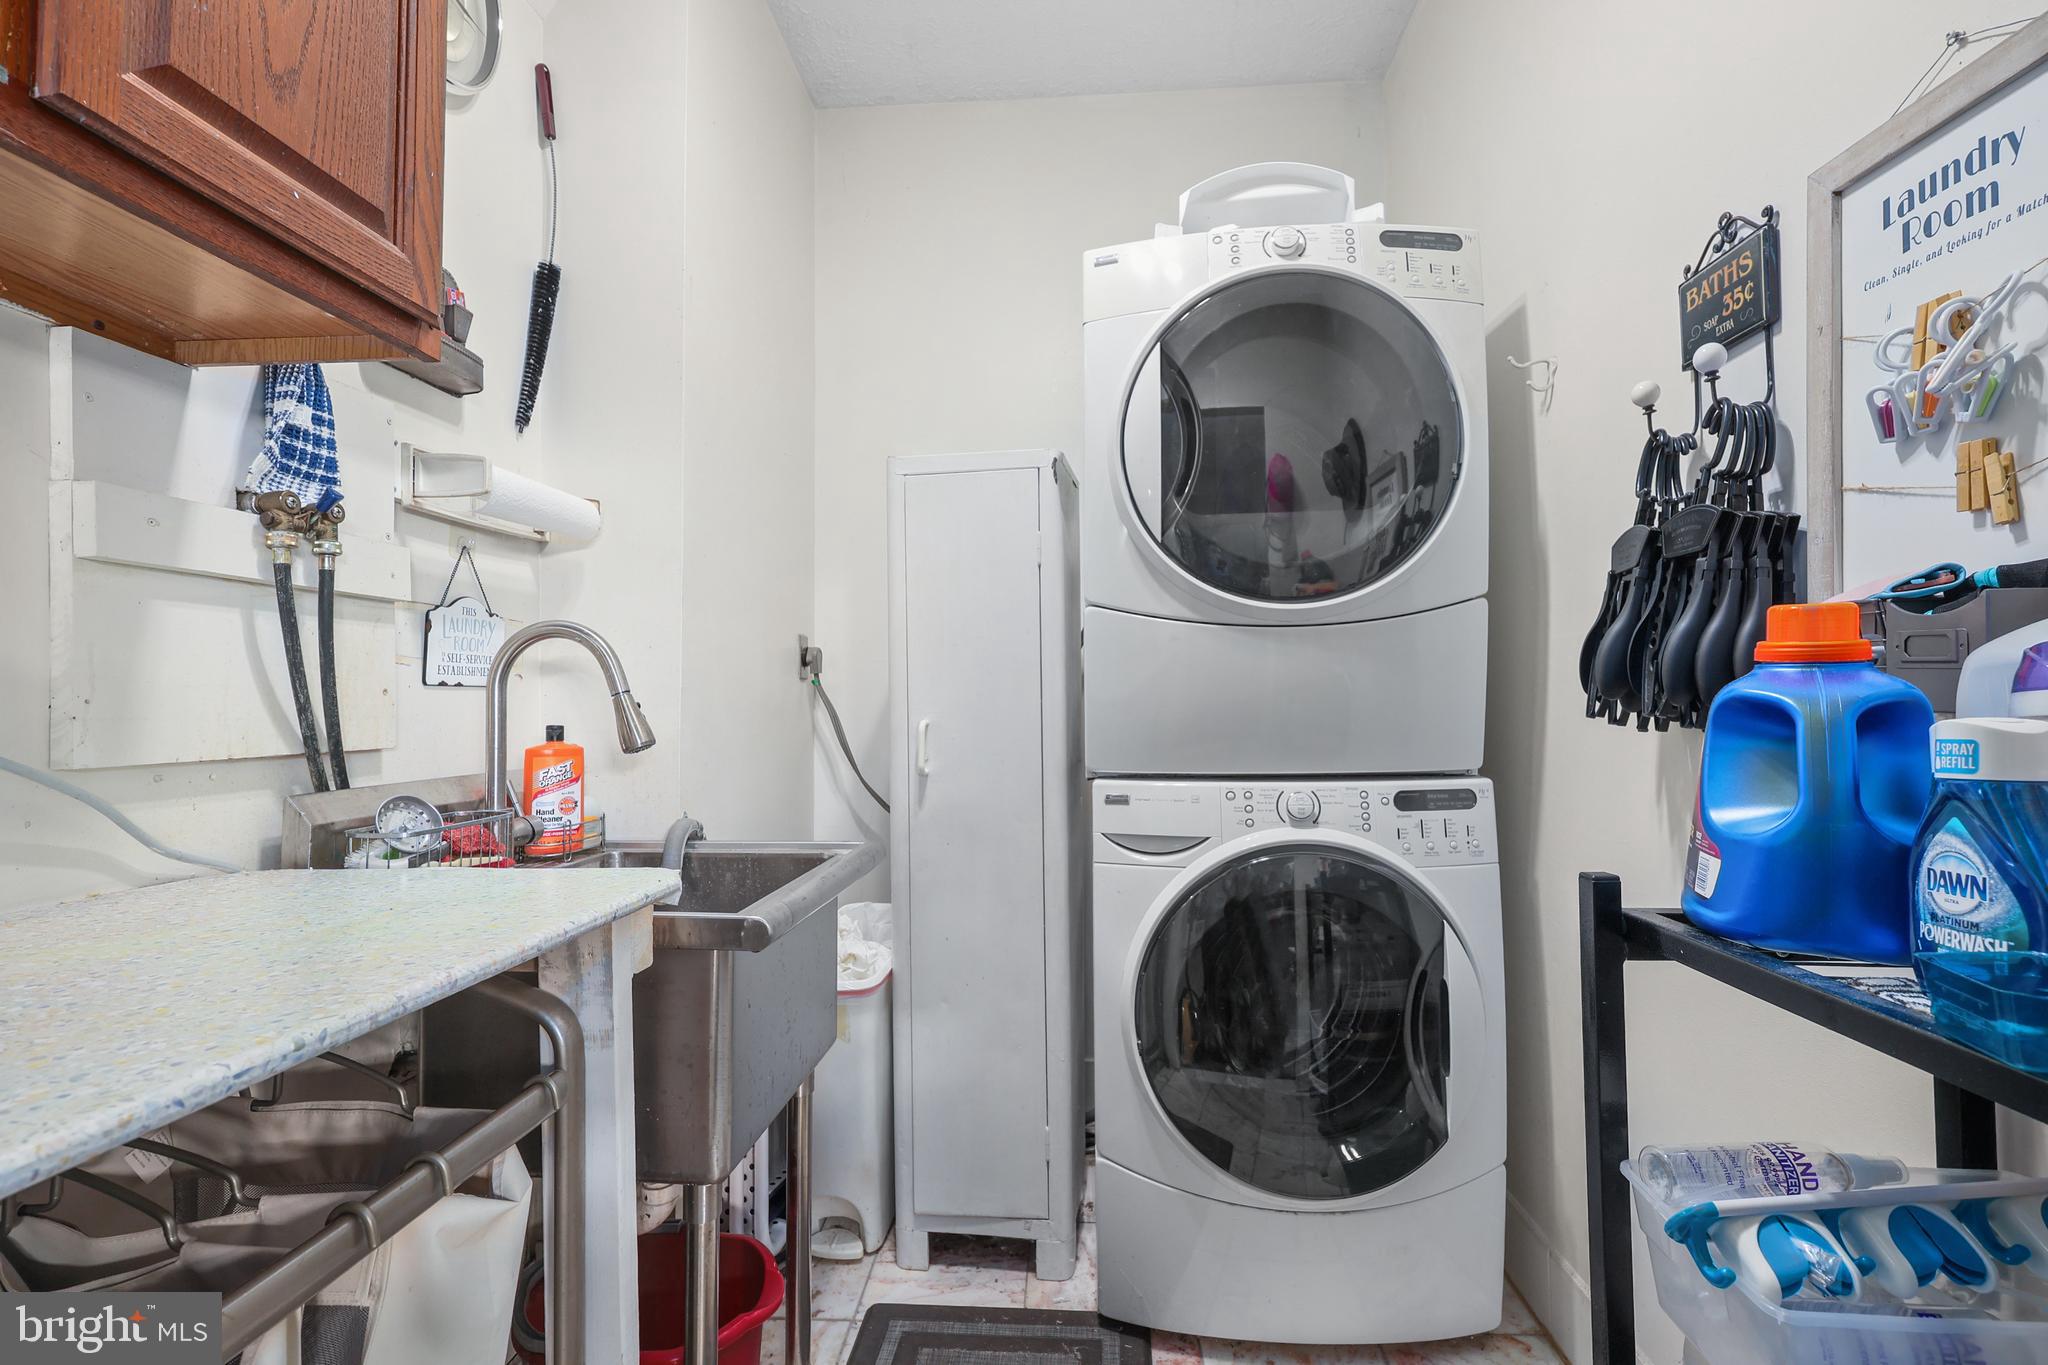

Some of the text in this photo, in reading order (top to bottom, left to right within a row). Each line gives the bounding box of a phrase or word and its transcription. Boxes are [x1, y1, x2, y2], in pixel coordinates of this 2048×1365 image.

[1882, 125, 2026, 231] Laundry
[1863, 275, 1889, 292] Clean,
[1892, 258, 1923, 279] Single,
[1925, 245, 1943, 262] and
[1946, 228, 1983, 254] Looking
[1985, 217, 2002, 236] for
[2005, 213, 2012, 223] a
[1686, 249, 1754, 313] BATHS
[1721, 280, 1754, 317] 35¢
[1703, 315, 1719, 332] SOAP
[1715, 318, 1735, 337] EXTRA
[461, 606, 477, 617] THIS
[442, 614, 496, 646] LAUNDRY
[454, 636, 485, 652] ROOM
[446, 653, 492, 665] SELF-SERVICE
[437, 665, 489, 677] ESTABLISHME
[1940, 742, 1975, 756] SPRAY
[539, 760, 574, 781] FAST
[1940, 756, 1976, 769] REFILL
[539, 771, 574, 788] ORANGE
[538, 815, 563, 823] leaner
[1926, 866, 1989, 902] DAWN
[1930, 911, 1980, 932] PLATINUM
[1919, 920, 2009, 953] POWERWASH
[1719, 1145, 1740, 1169] cohol
[1776, 1142, 1819, 1191] HAND
